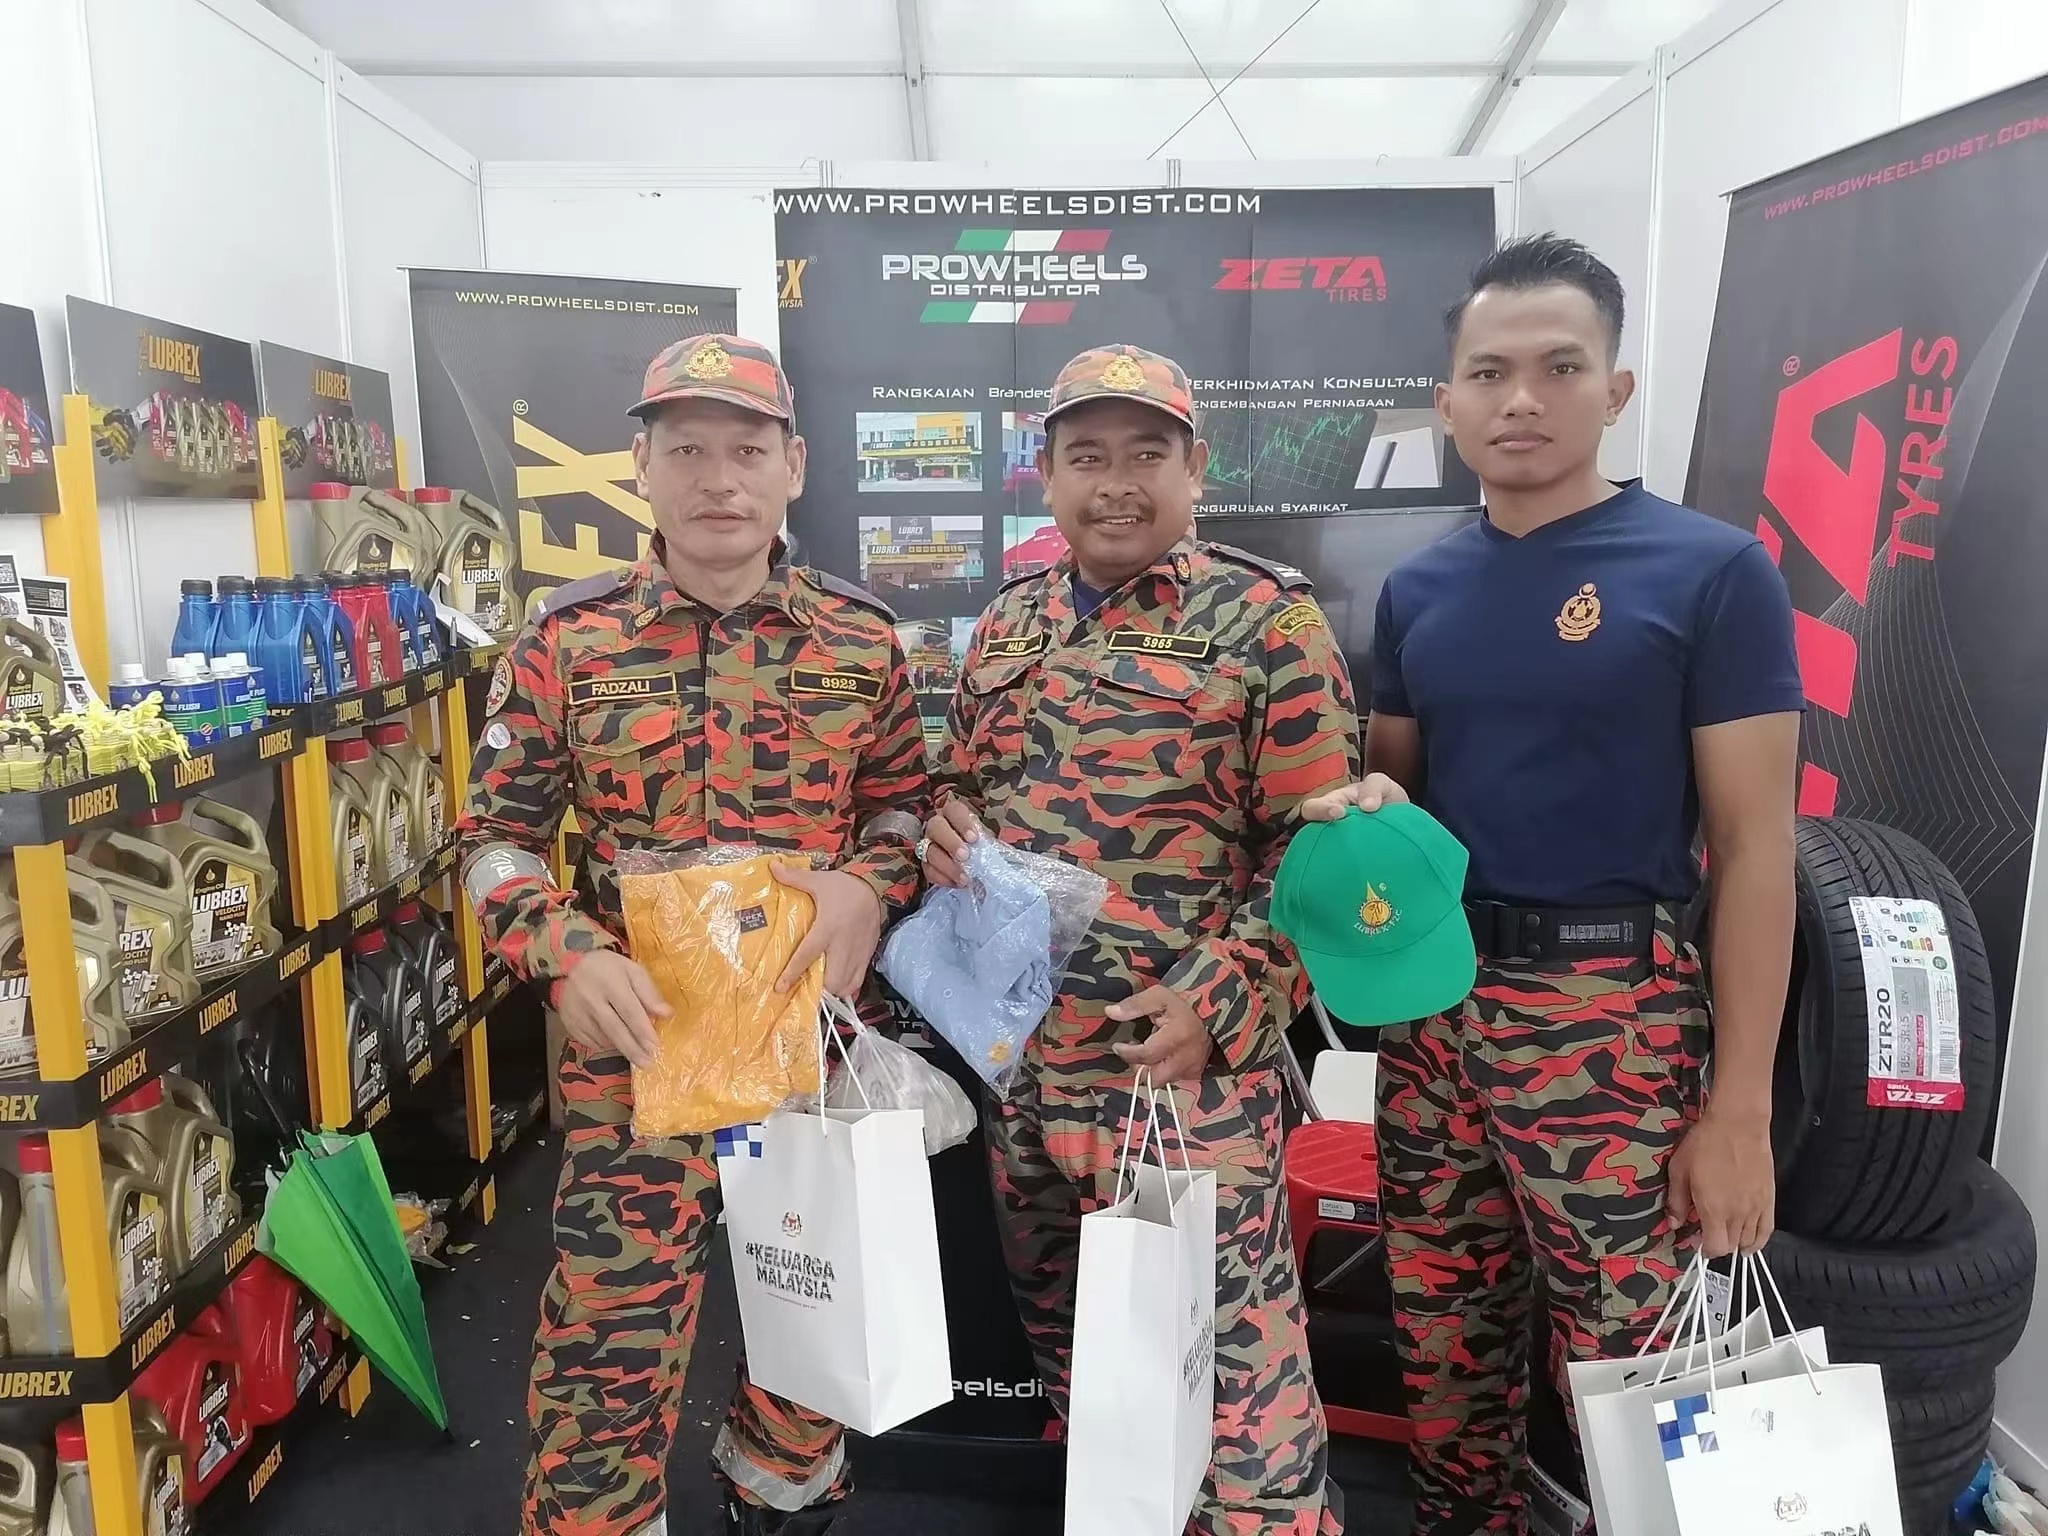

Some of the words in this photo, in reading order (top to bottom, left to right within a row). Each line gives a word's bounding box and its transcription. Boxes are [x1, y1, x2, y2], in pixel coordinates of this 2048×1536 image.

[773, 194, 1261, 215] WWW.PROWHEELSDIST.COM
[882, 254, 1148, 281] PROWHEELS
[1211, 255, 1387, 291] ZETA
[455, 289, 699, 316] WWW.PROWHEELSDIST.COM
[931, 284, 1101, 297] DISTRIBUTOR
[1326, 286, 1387, 303] TIRES
[148, 334, 200, 377] LUBREX
[314, 368, 352, 401] LUBREX
[872, 386, 975, 398] RANGKAIAN
[1191, 399, 1297, 409] ENGEMBANGAN
[1887, 335, 1959, 567] TYRES
[1191, 504, 1275, 513] ENGURUSAN
[462, 567, 501, 584] LUBREX
[1006, 640, 1028, 652] HADI
[1142, 636, 1174, 650] 5965
[591, 679, 650, 696] FADZALI
[820, 676, 858, 691] 6922
[5, 692, 44, 710] LUBREX
[259, 729, 293, 760] LUBREX
[173, 752, 216, 788] LUBREX
[67, 783, 119, 826] LUBREX
[191, 884, 249, 915] LUBREX
[214, 903, 247, 916] VELOCITY
[122, 949, 150, 961] OCITY
[278, 941, 312, 981] LUBREX
[198, 989, 238, 1036] LUBREX
[1875, 987, 1892, 1073] ZTR20
[99, 1047, 148, 1103] LUBREX
[1885, 1089, 1946, 1106] ZETA
[193, 1159, 220, 1189] LUBREX
[120, 1211, 156, 1255] LUBREX
[222, 1220, 259, 1276] LUBREX
[745, 1241, 835, 1281] #KELUARGA
[755, 1263, 834, 1303] MALAYSIA
[131, 1303, 176, 1371] LUBREX
[318, 1352, 348, 1405] LUBREX
[198, 1378, 230, 1423] LUBREX
[247, 1440, 283, 1503] LUBREX
